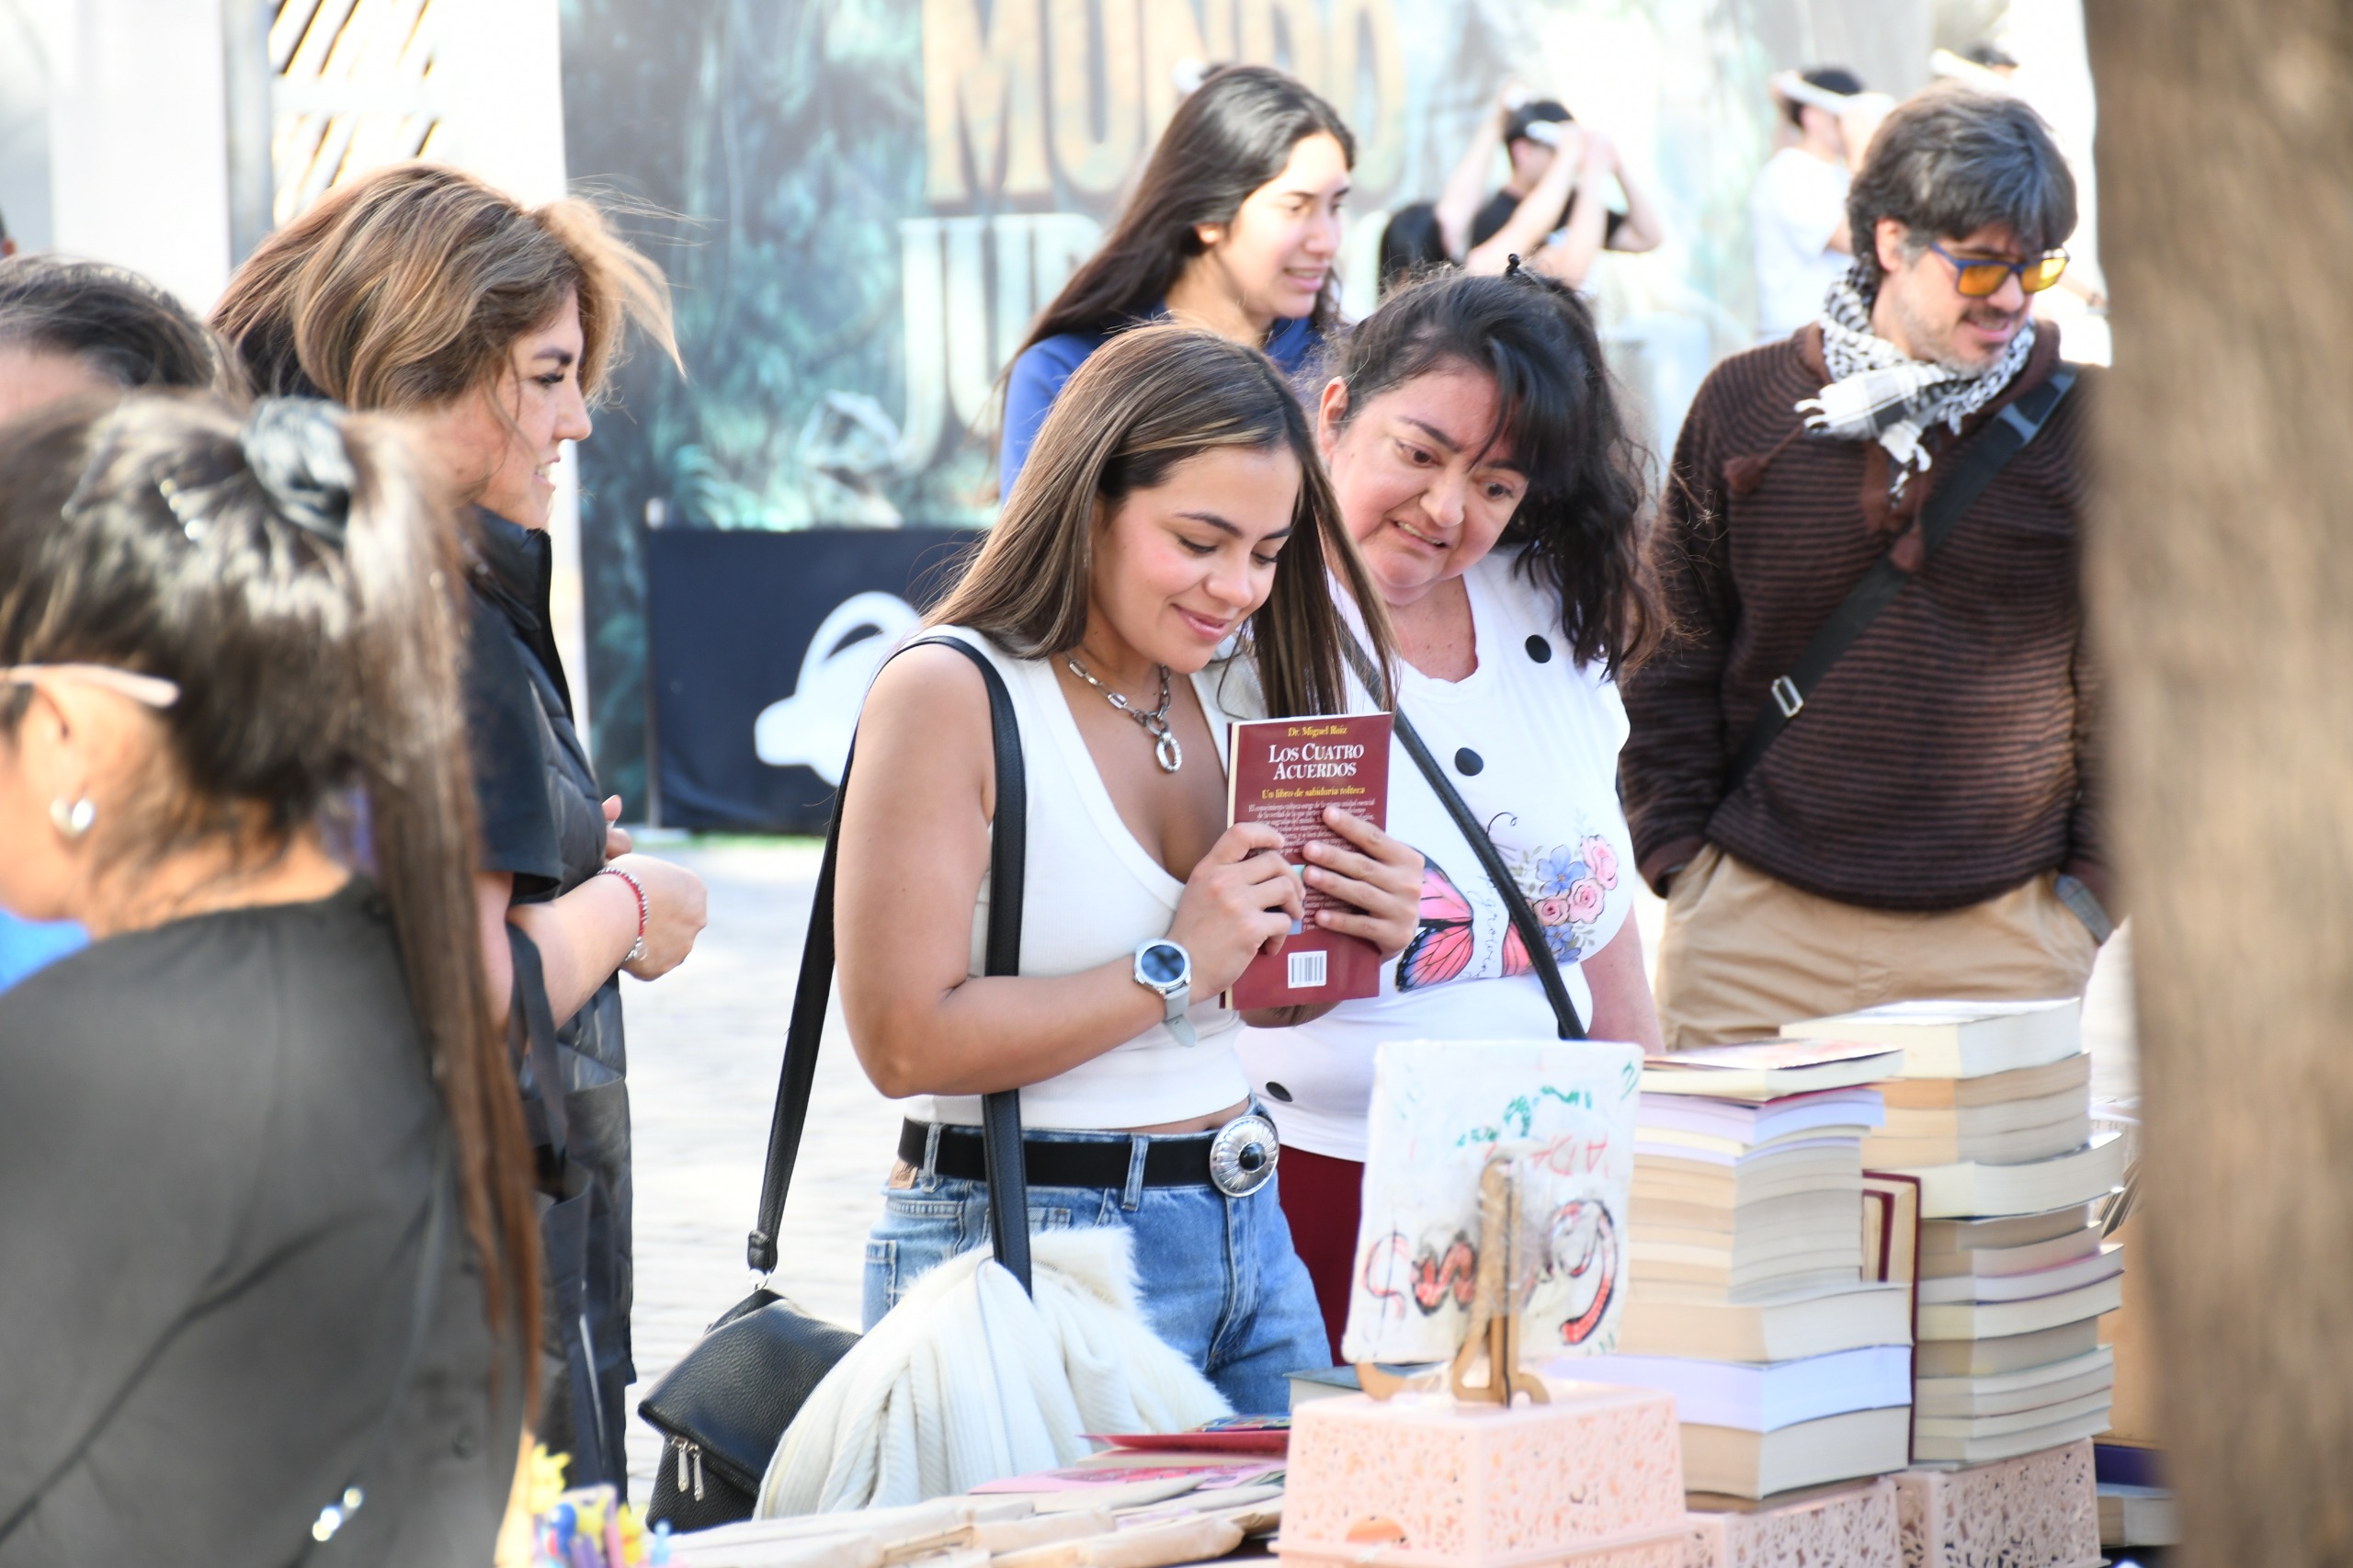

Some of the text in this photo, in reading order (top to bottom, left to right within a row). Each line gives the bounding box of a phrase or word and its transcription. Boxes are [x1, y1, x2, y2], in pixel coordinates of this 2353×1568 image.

[1288, 727, 1301, 737] Dr.
[1302, 725, 1329, 739] Miguel
[1267, 743, 1365, 763] LOS CUATRO
[1273, 762, 1358, 780] ACUERDOS
[1261, 785, 1366, 800] Un libro de sabiduría tolteca
